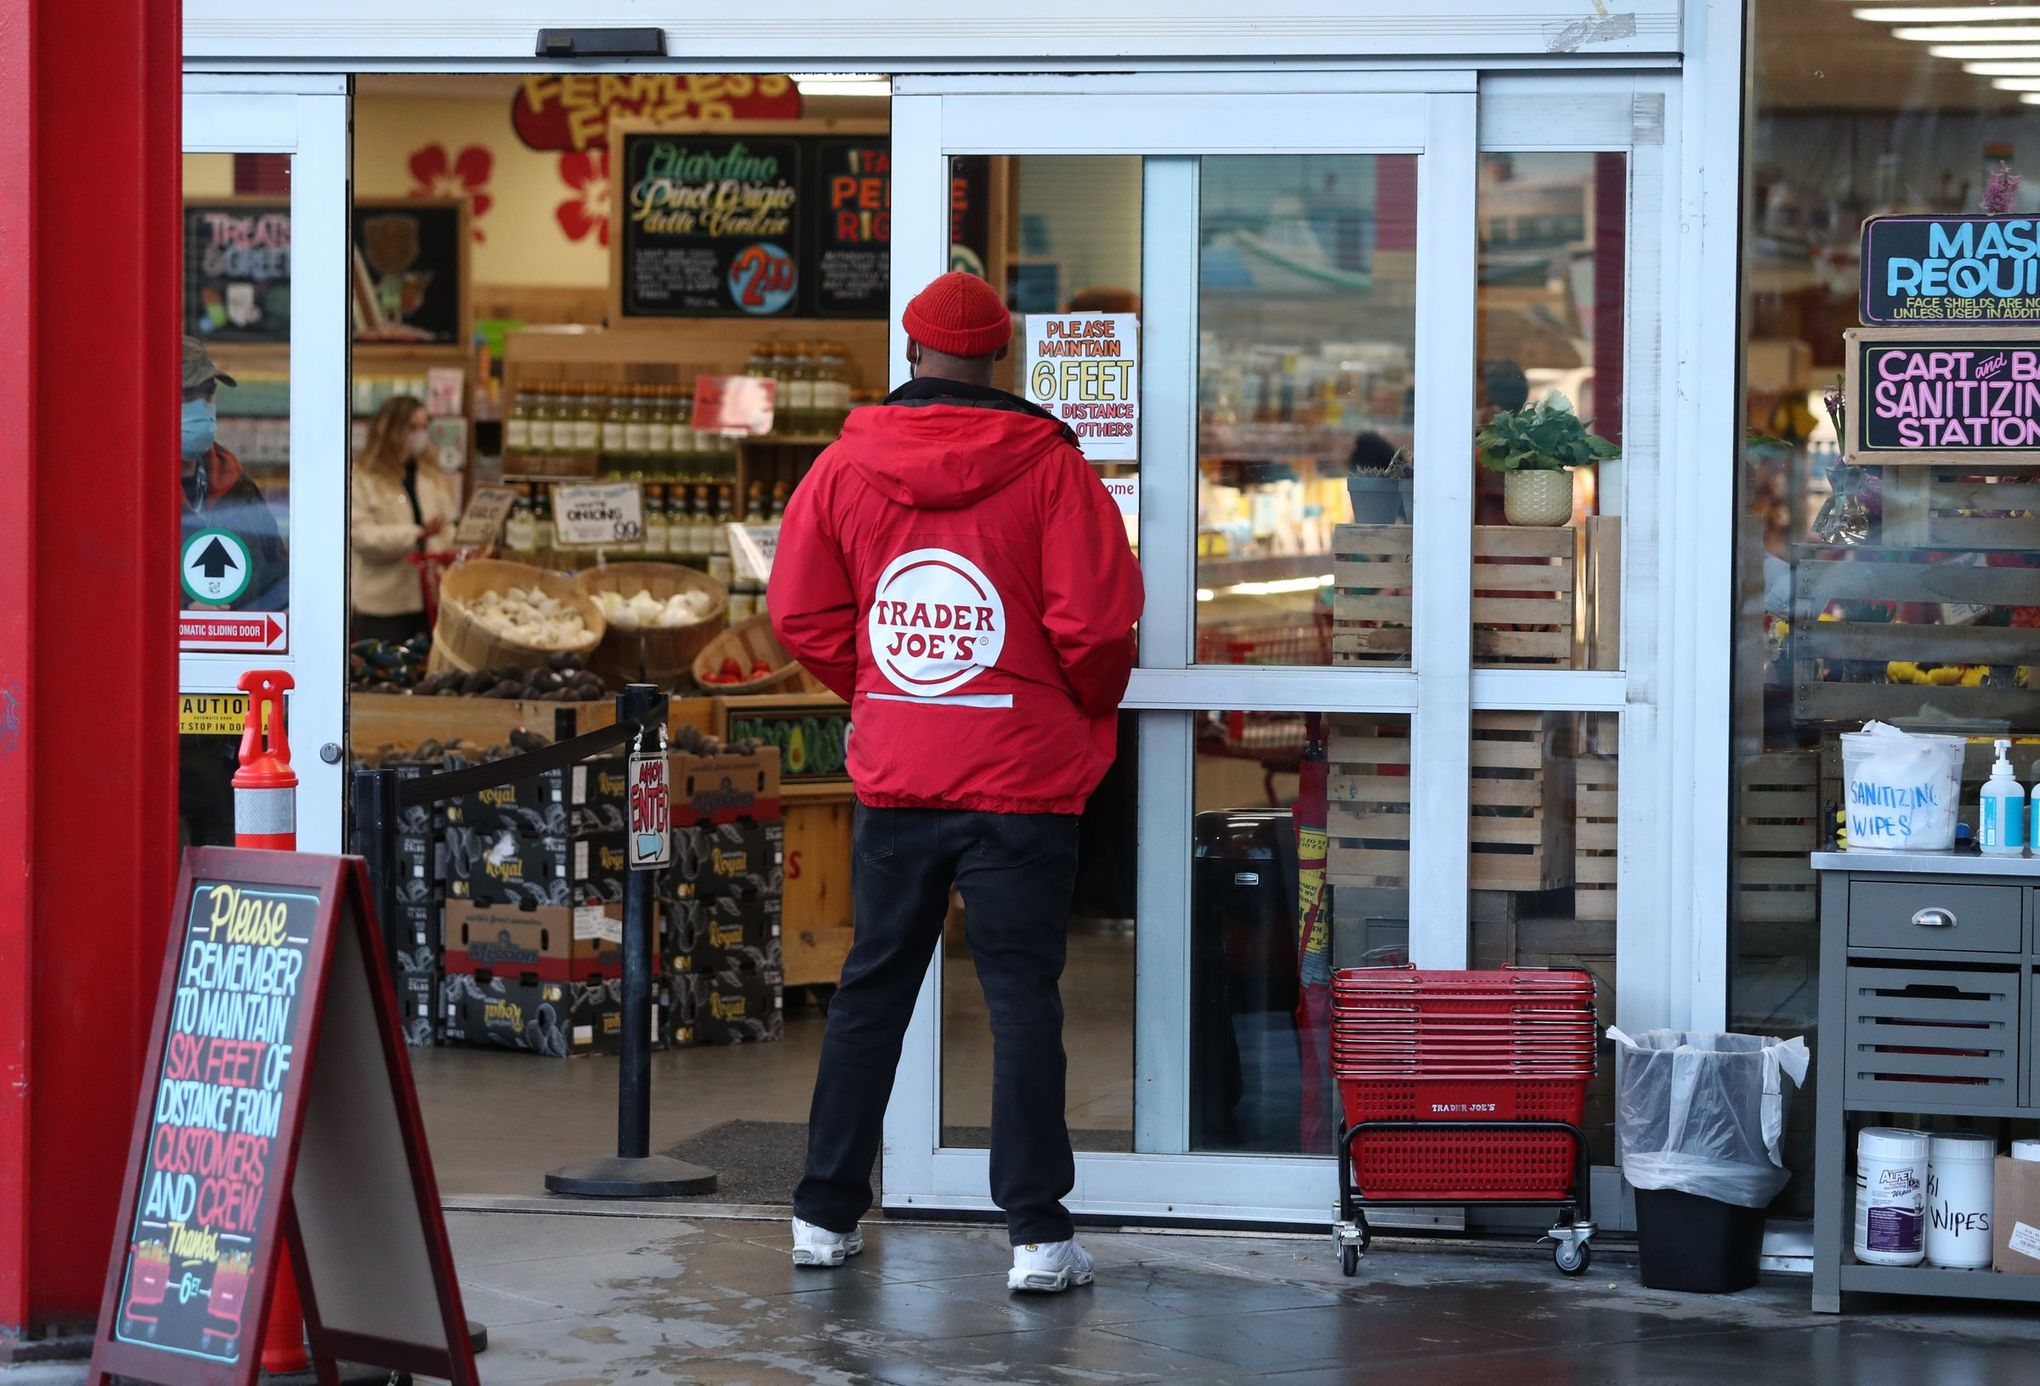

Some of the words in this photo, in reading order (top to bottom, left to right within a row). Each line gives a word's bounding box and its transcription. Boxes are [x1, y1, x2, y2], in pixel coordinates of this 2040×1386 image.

[1929, 219, 2040, 261] MAS
[1893, 308, 1944, 319] UNLESS
[1947, 308, 1983, 319] USED
[1986, 308, 2000, 319] IN
[1906, 297, 1940, 309] FACE
[1944, 297, 1995, 309] SHIELDS
[1997, 297, 2023, 309] ARE
[1046, 320, 1115, 338] PLEASE
[1038, 339, 1121, 357] MAINTAIN
[1031, 360, 1057, 401] 6
[1059, 360, 1135, 401] FEET
[1878, 350, 1975, 382] CART
[1975, 352, 2008, 379] and
[1061, 403, 1134, 419] DISTANCE
[1076, 421, 1133, 437] OTHERS
[208, 625, 238, 637] SLIDING
[240, 626, 261, 637] DOOR
[875, 599, 996, 632] TRADER
[886, 631, 978, 661] JOE'S
[188, 722, 212, 731] STOP
[215, 723, 226, 731] IN
[631, 782, 669, 834] ENTER
[1852, 814, 1912, 838] WIPES
[209, 885, 288, 947] Please
[185, 940, 303, 996] REMEMBER
[177, 987, 199, 1035] TO
[198, 990, 291, 1045] MAINTAIN
[166, 1033, 206, 1080] SIX
[204, 1038, 268, 1087] FEET
[263, 1044, 293, 1091] OF
[157, 1078, 234, 1132] DISTANCE
[231, 1087, 283, 1139] FROM
[1431, 1103, 1468, 1112] TRADER
[1468, 1103, 1496, 1112] JOE'S
[153, 1123, 269, 1186] CUSTOMERS
[144, 1170, 197, 1223] AND
[1930, 1200, 1990, 1237] WIPES
